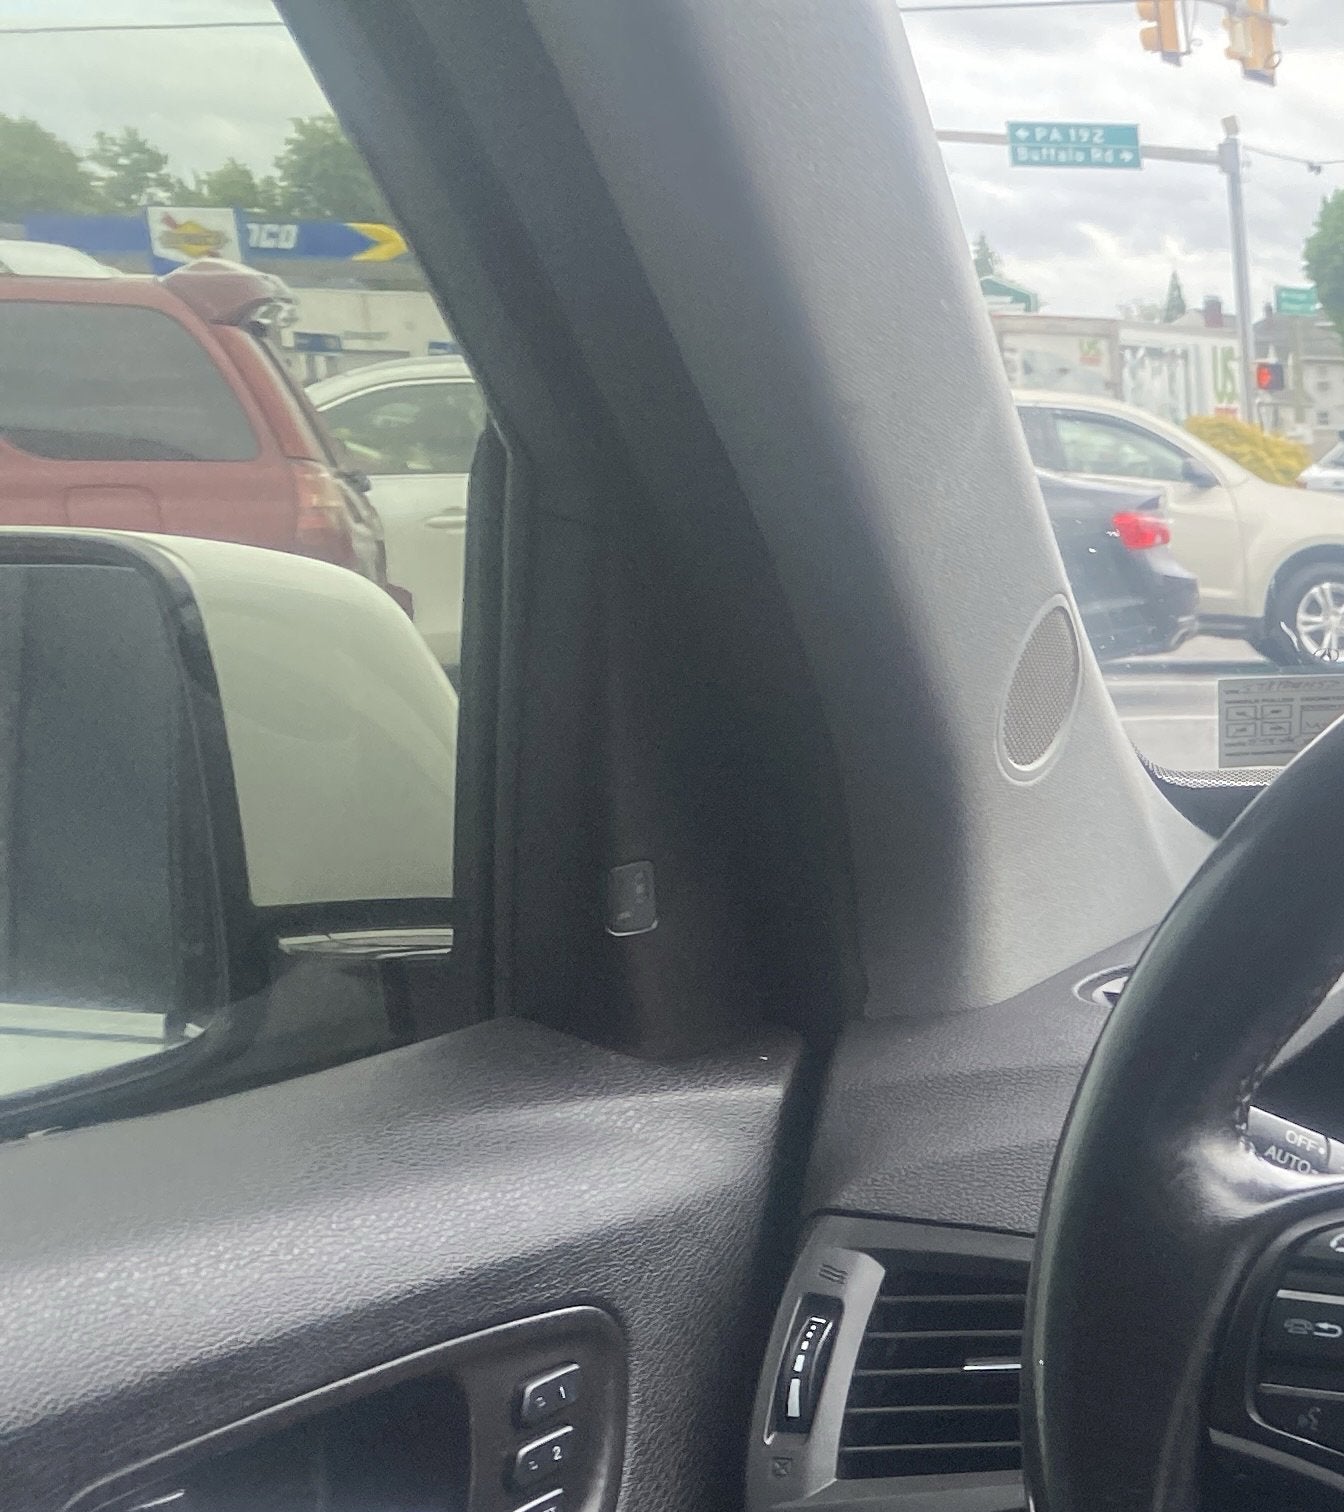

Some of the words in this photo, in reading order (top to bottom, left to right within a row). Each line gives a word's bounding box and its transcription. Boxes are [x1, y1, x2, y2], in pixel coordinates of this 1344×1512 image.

[1034, 126, 1063, 142] PA
[1068, 127, 1105, 144] 192
[1090, 147, 1115, 164] Rd
[1285, 1130, 1320, 1153] OFF
[1264, 1144, 1312, 1174] AUTO
[559, 1386, 567, 1399] 1
[552, 1445, 563, 1461] 2
